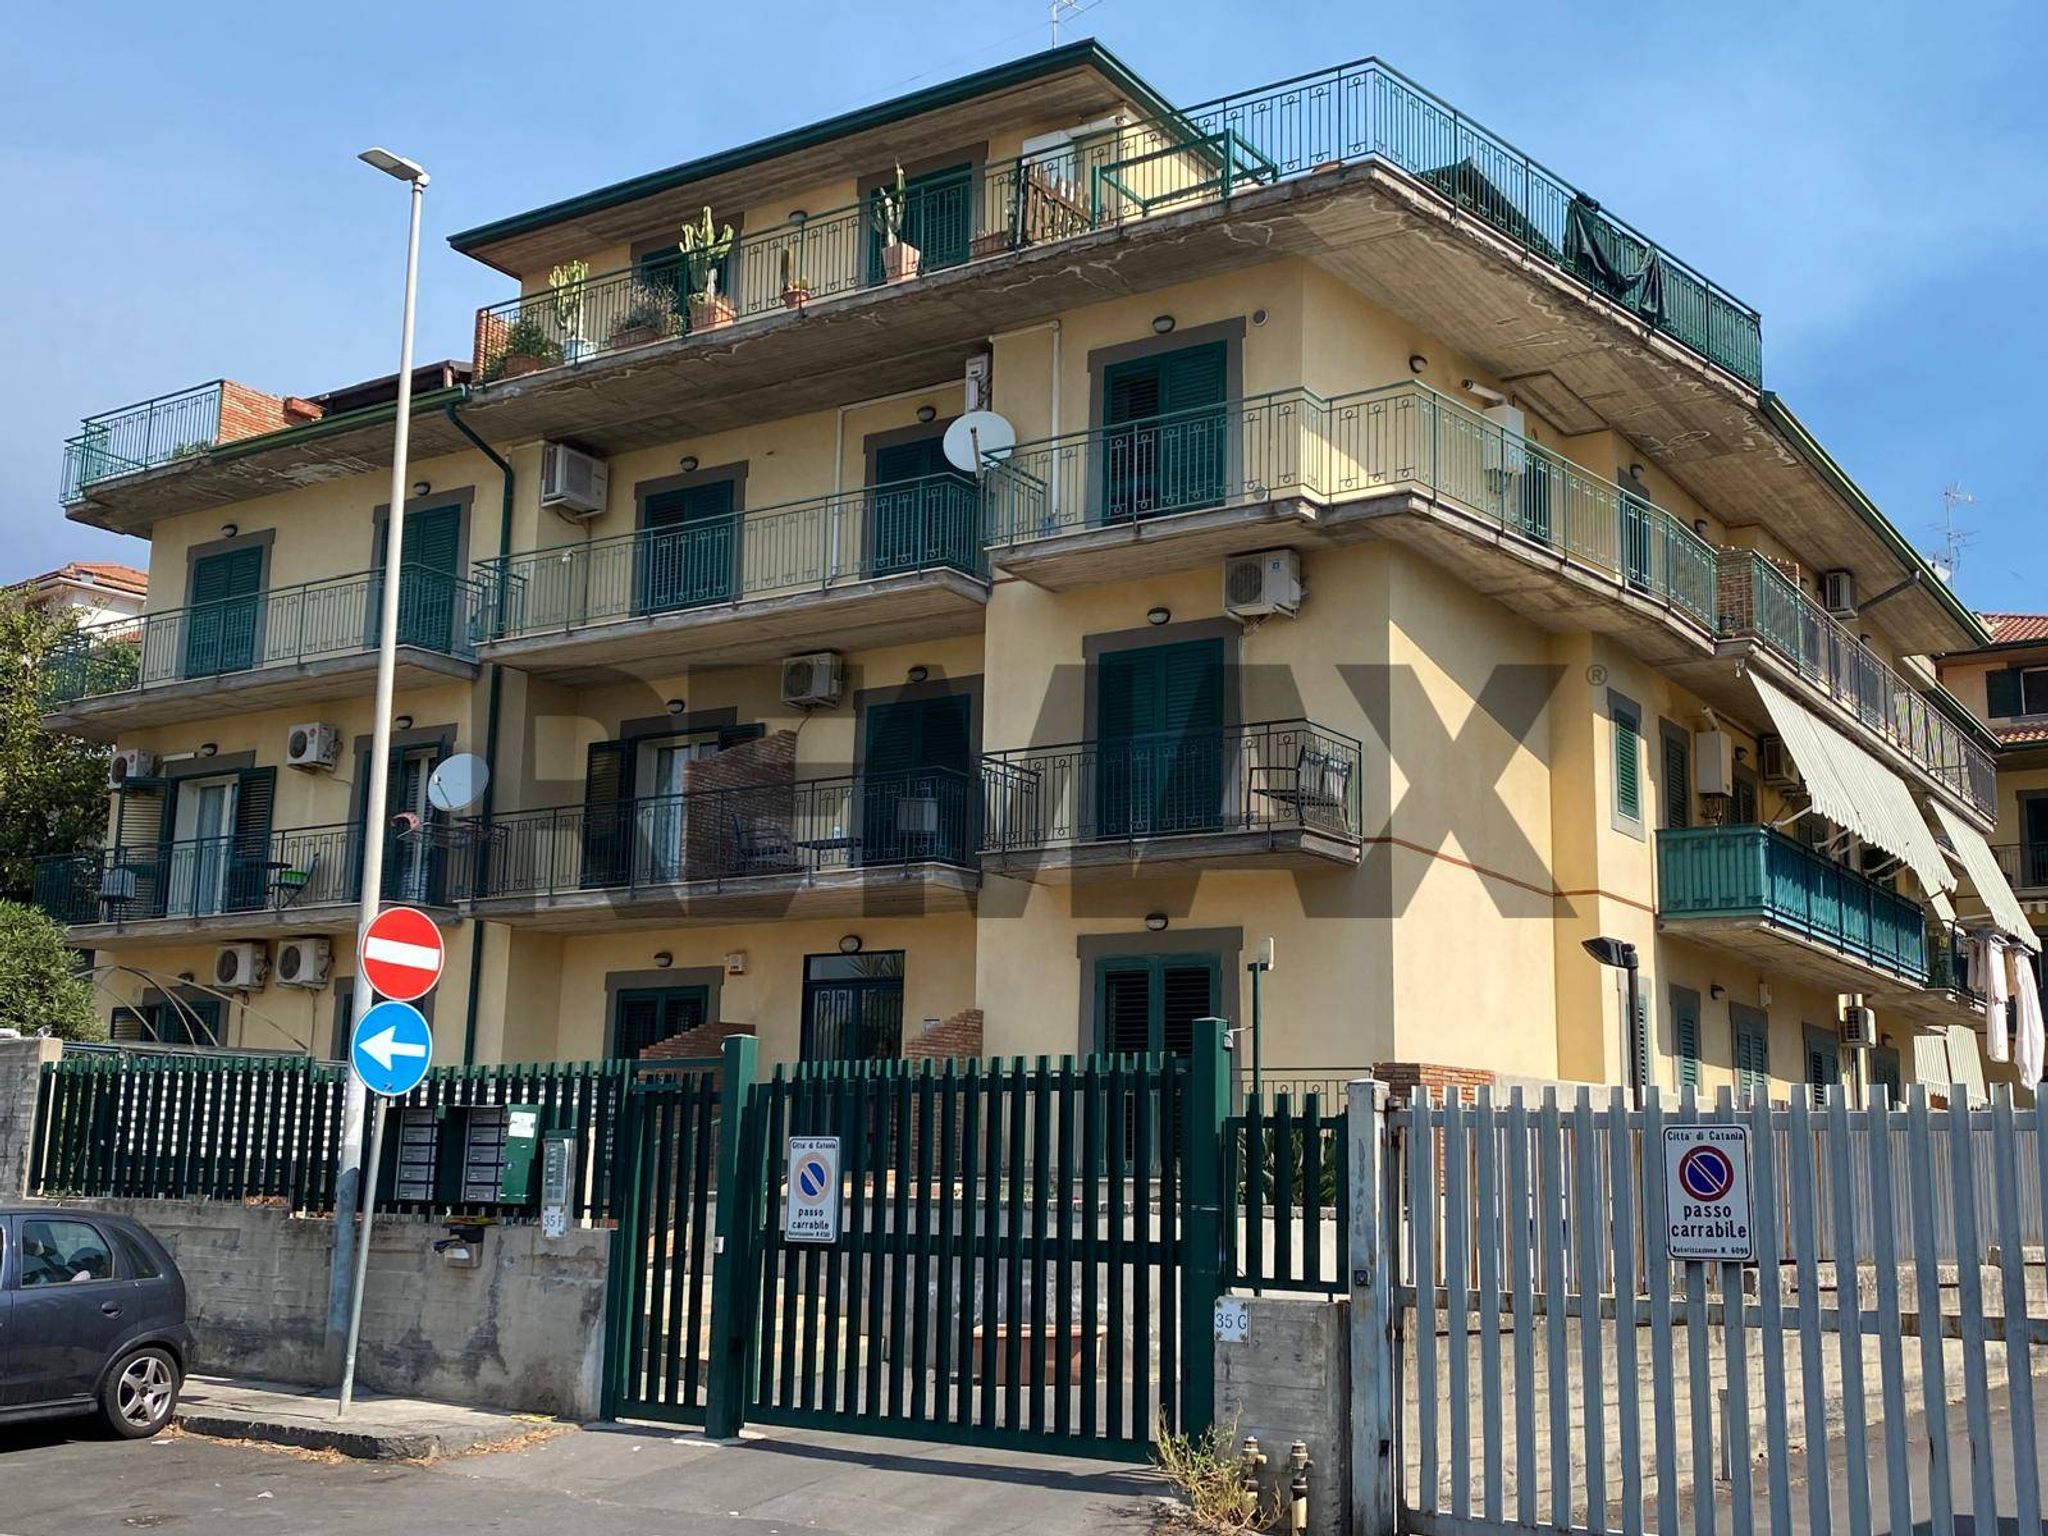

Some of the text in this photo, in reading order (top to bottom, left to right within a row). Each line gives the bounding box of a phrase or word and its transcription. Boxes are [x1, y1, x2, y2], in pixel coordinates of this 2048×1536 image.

[1696, 1131, 1704, 1140] di
[1708, 1131, 1743, 1140] Catania
[798, 1208, 824, 1218] passo
[1684, 1205, 1732, 1220] passo
[792, 1220, 830, 1230] carrabile
[1671, 1221, 1747, 1238] carrabile
[1216, 1313, 1233, 1329] 35
